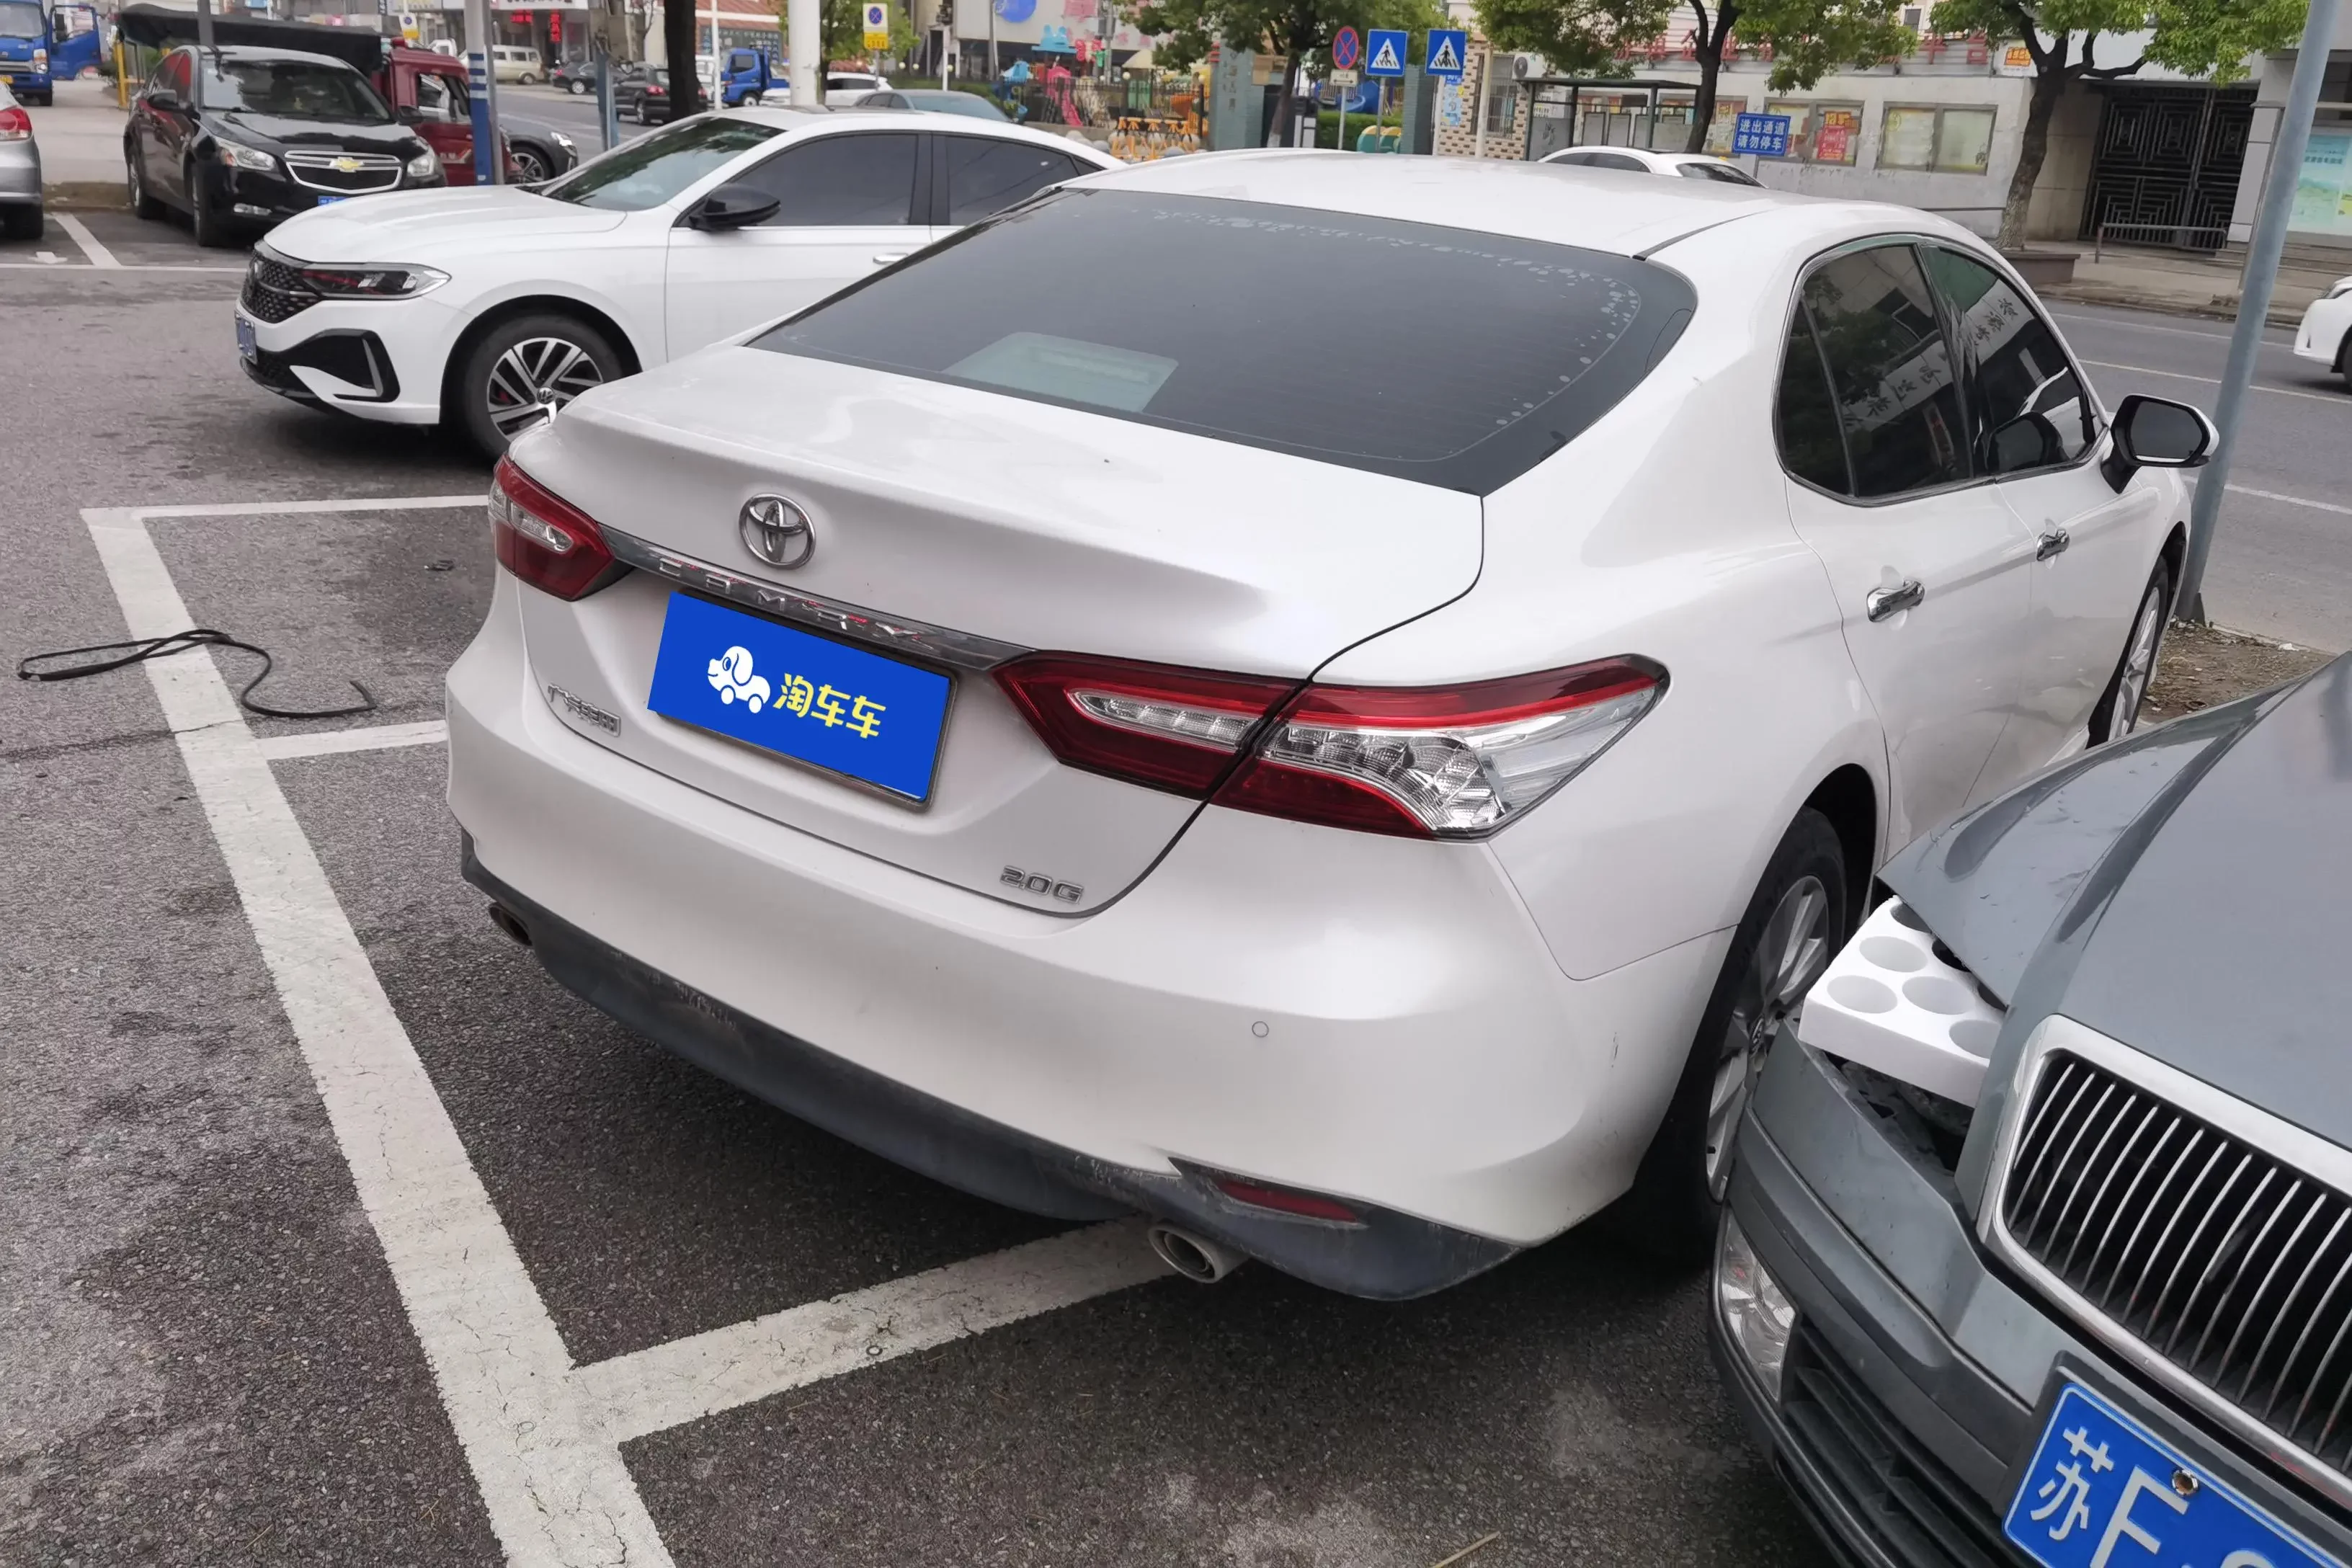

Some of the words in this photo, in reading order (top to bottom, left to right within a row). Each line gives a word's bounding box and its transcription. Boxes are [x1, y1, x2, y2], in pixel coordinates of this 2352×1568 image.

[1737, 133, 1783, 151] 请勿停车
[1739, 118, 1786, 135] 进出通道
[659, 558, 919, 644] CAMRY
[999, 865, 1084, 905] 2.0G
[2030, 1425, 2278, 1568] 苏F
